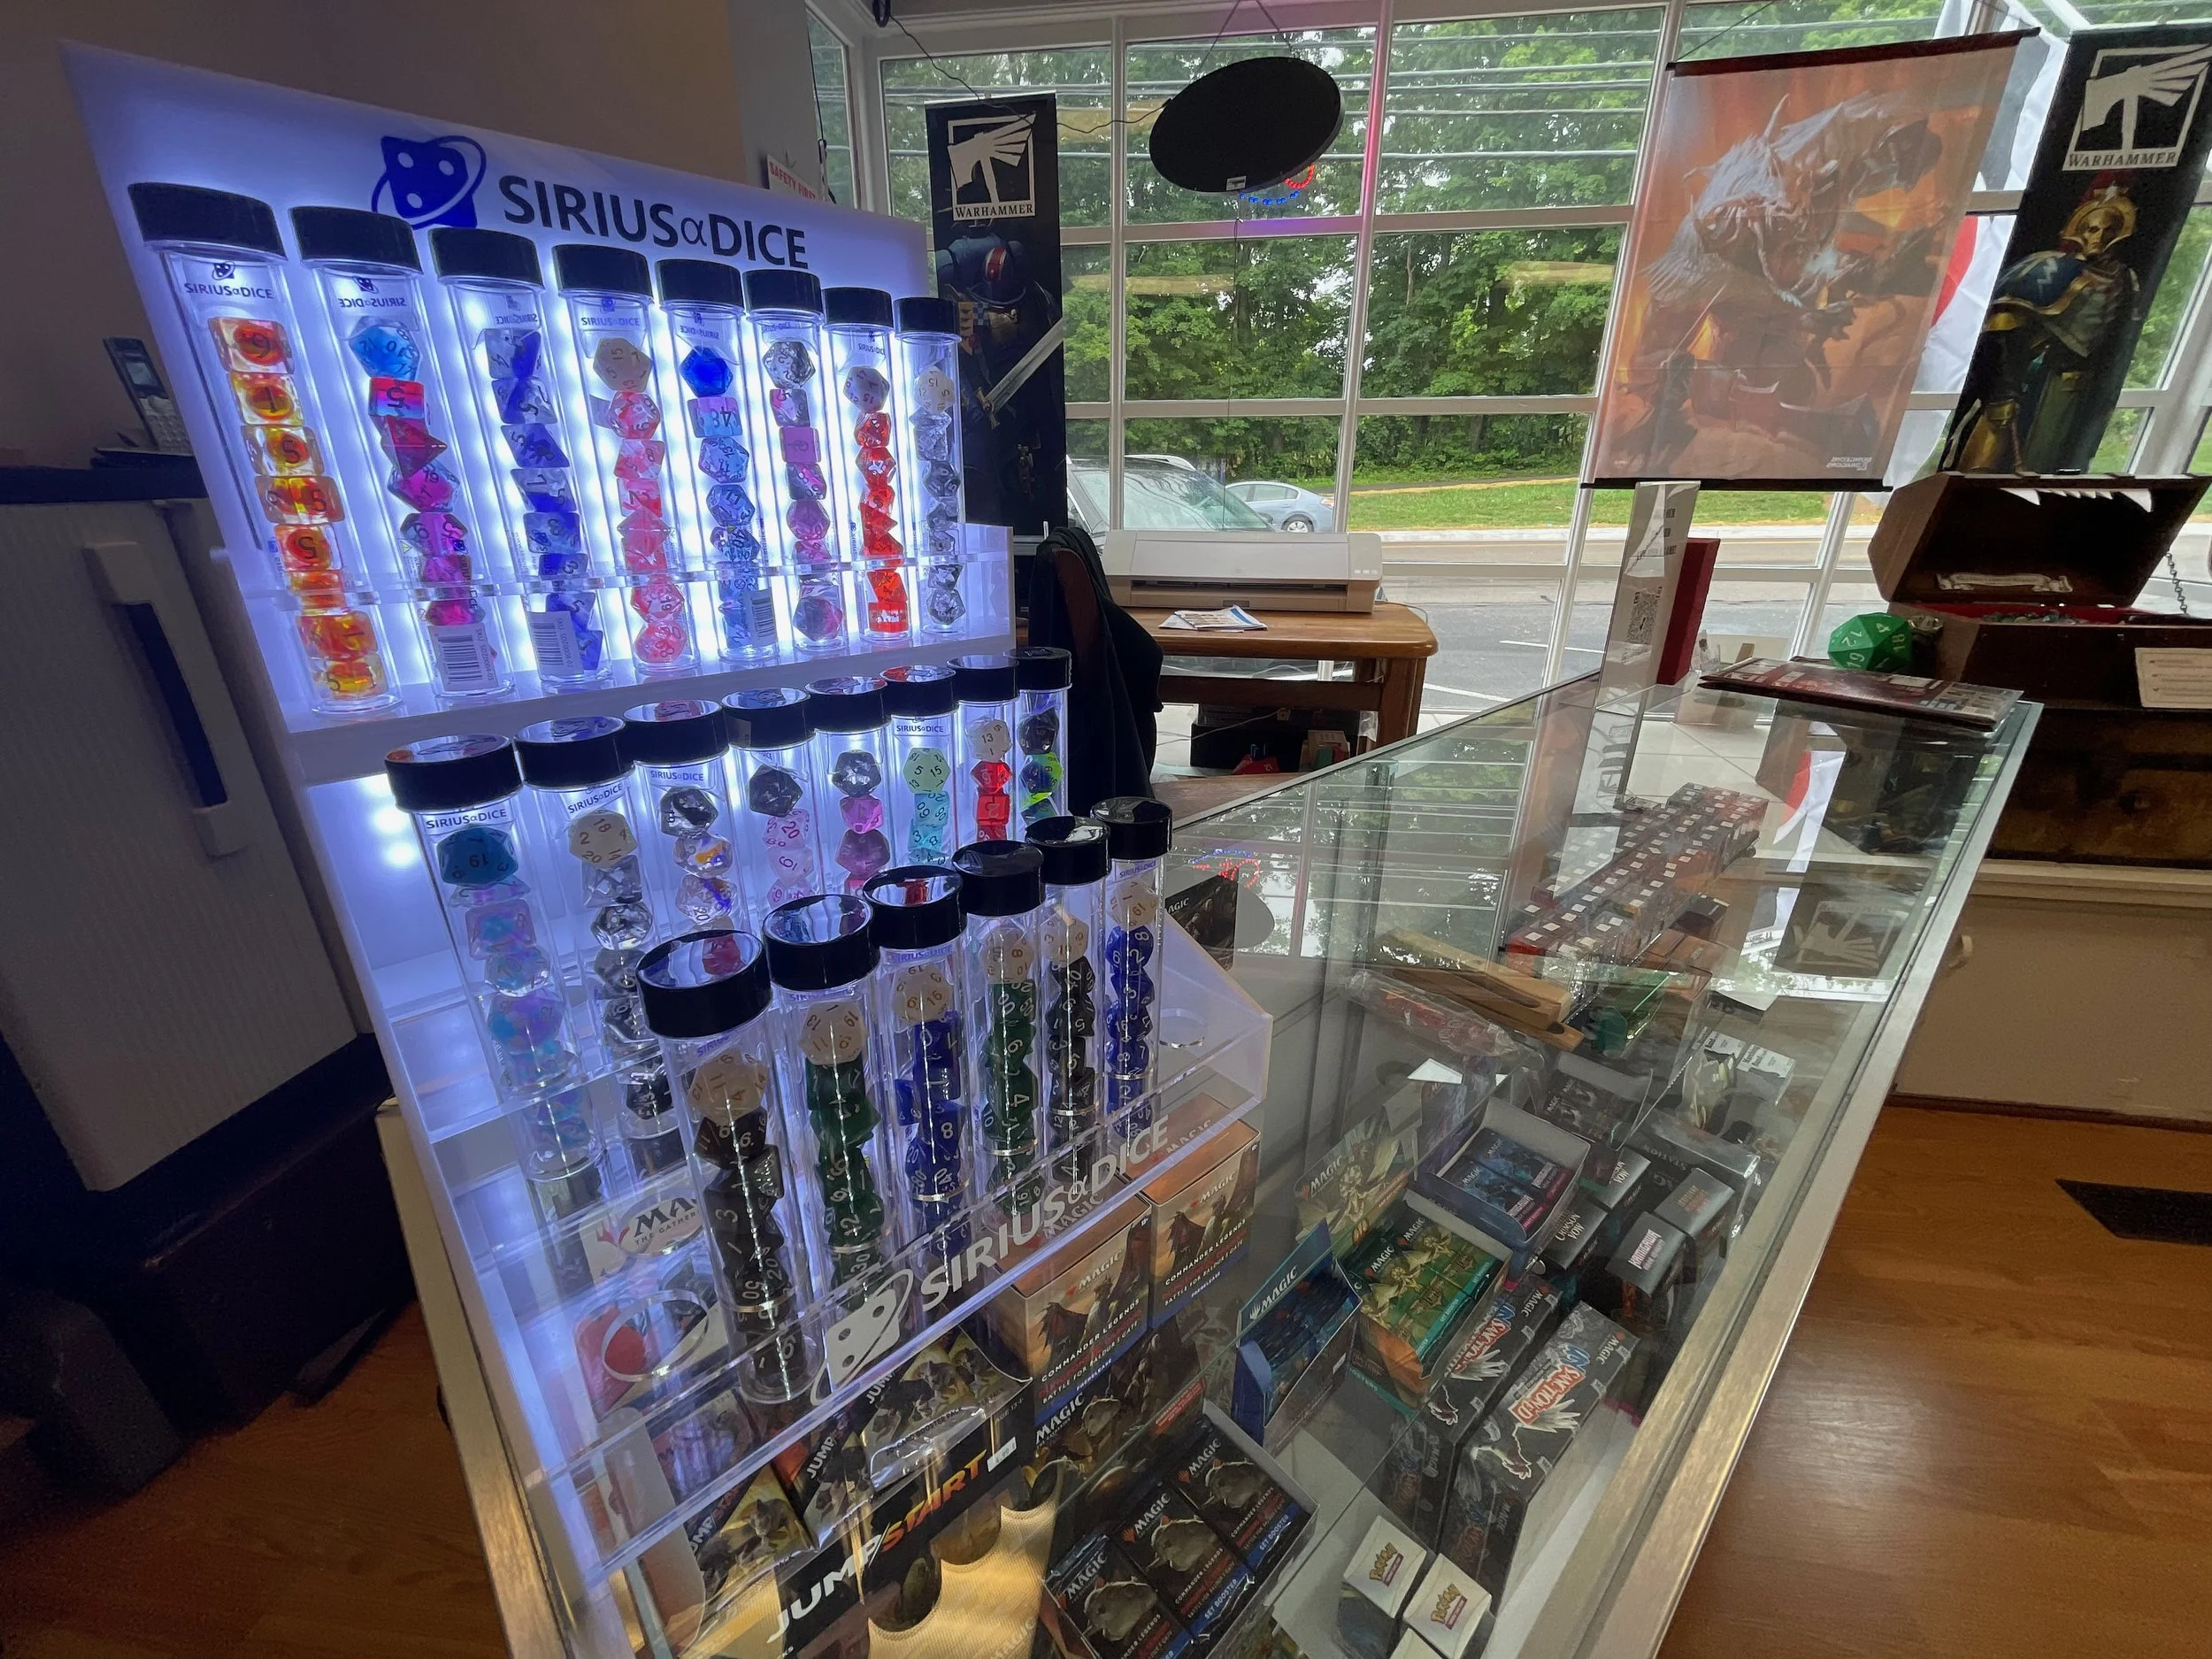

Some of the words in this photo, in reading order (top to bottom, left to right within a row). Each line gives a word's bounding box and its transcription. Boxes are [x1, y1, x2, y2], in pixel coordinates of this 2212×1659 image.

[2068, 151, 2177, 167] WARHAMMER
[955, 203, 1033, 219] WARHAMMER
[1876, 623, 1891, 634] 4
[980, 733, 994, 744] 13
[914, 764, 925, 776] 5
[929, 764, 943, 778] 15
[578, 832, 590, 846] 2
[781, 820, 801, 840] 20
[581, 849, 603, 864] 20
[1134, 931, 1150, 941] 8
[1128, 948, 1146, 964] 2
[941, 1121, 954, 1139] 8
[1310, 1153, 1343, 1194] MAGIC
[1615, 1168, 1630, 1185] VOW
[1198, 1172, 1235, 1205] MAGIC
[634, 1197, 698, 1238] MA
[1402, 1217, 1426, 1242] MAGIC
[1555, 1212, 1581, 1241] CRIMSON
[1567, 1222, 1586, 1240] VOW
[1164, 1246, 1215, 1286] COMMANDER
[1215, 1217, 1248, 1249] LEGENDS
[1371, 1245, 1395, 1273] MAGIC
[1078, 1249, 1123, 1291] MAGIC
[1164, 1286, 1188, 1307] BATTLE
[1260, 1265, 1299, 1313] MAGIC
[1521, 1290, 1544, 1317] MAGIC
[1041, 1332, 1101, 1383] COMMANDER
[1102, 1297, 1141, 1333] LEGENDS
[1596, 1334, 1620, 1365] MAGIC
[1072, 1365, 1087, 1381] FOR
[1034, 1392, 1087, 1445] MAGIC
[1187, 1437, 1223, 1476] MAGIC
[1133, 1492, 1172, 1535] MAGIC
[1258, 1540, 1270, 1552] SET
[1066, 1550, 1109, 1601] MAGIC
[1174, 1572, 1205, 1605] COMMANDER
[1204, 1607, 1217, 1621] SET
[1214, 1578, 1239, 1610] BOOSTER
